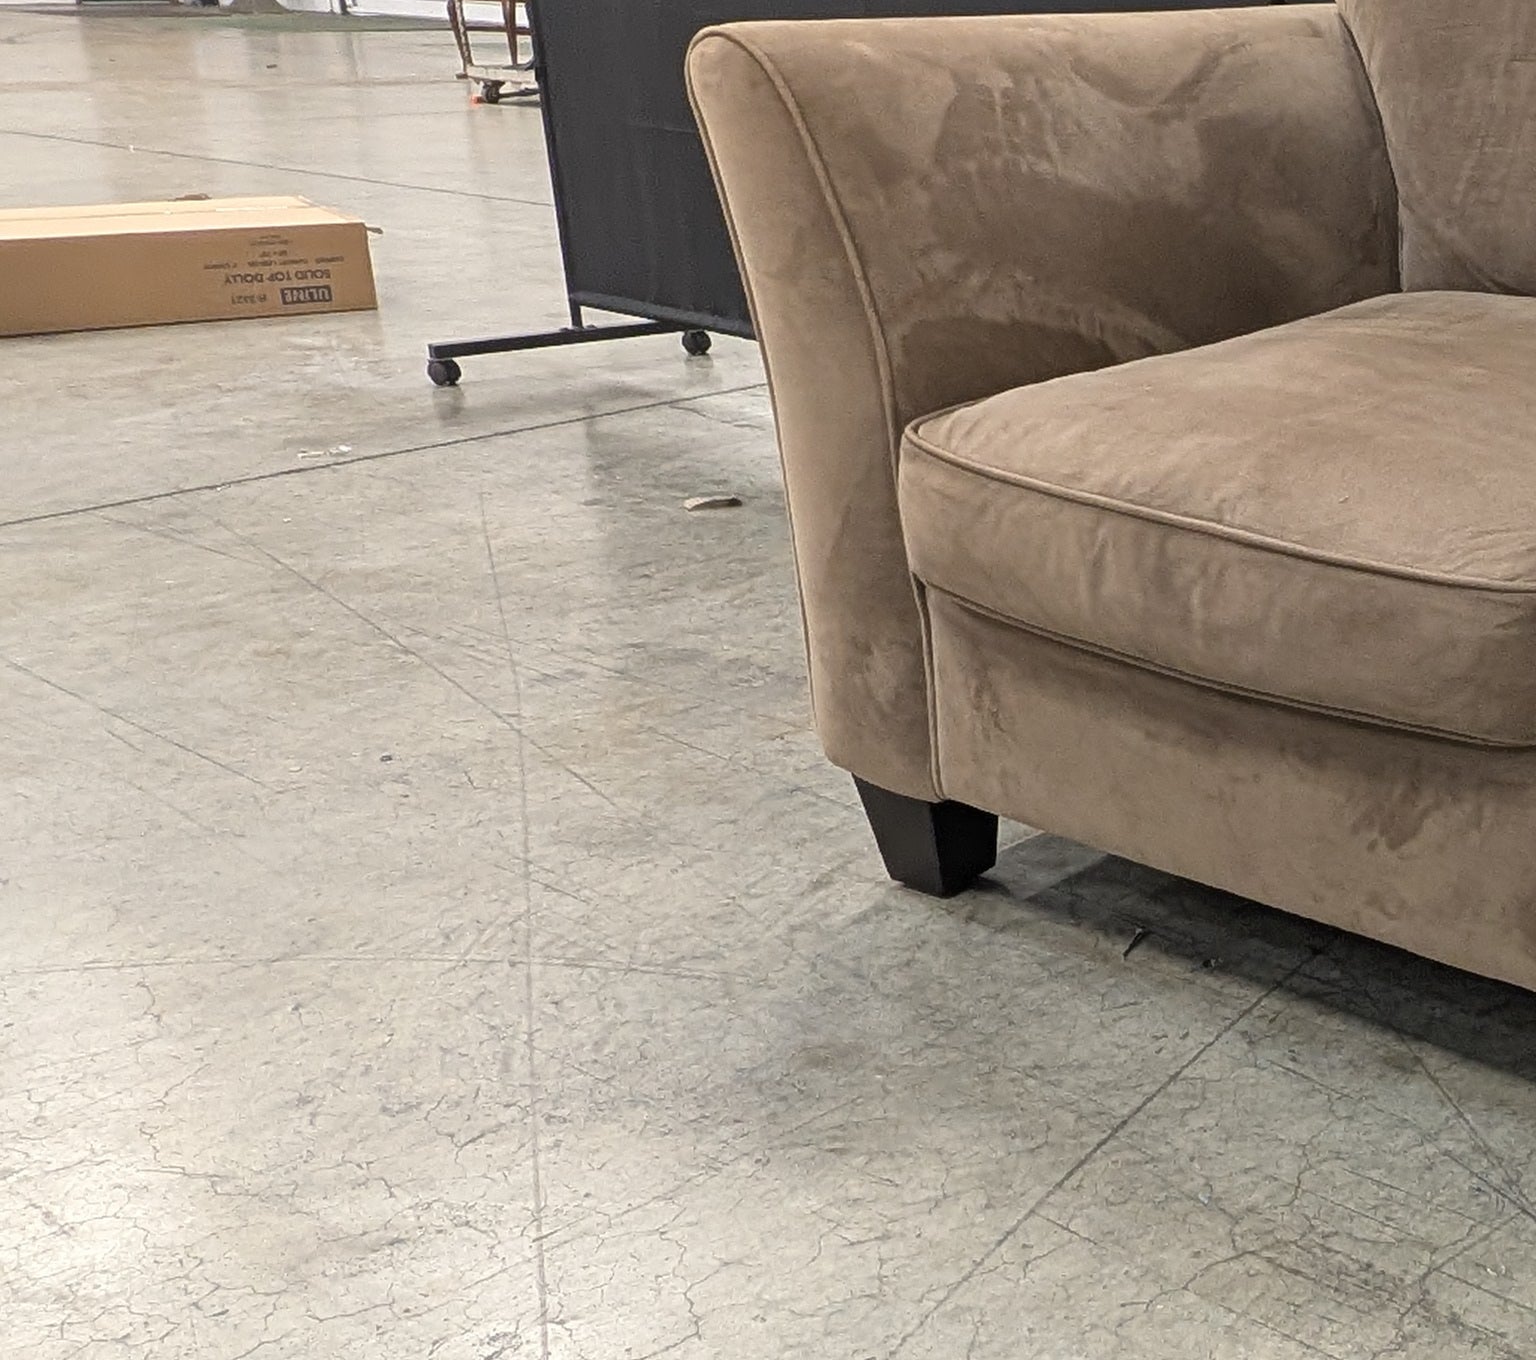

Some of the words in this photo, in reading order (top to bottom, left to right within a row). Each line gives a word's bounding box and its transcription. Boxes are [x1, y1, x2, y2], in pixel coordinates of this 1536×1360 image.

[224, 273, 264, 284] DOLLY
[266, 271, 292, 282] TOP
[283, 287, 330, 303] ULINE
